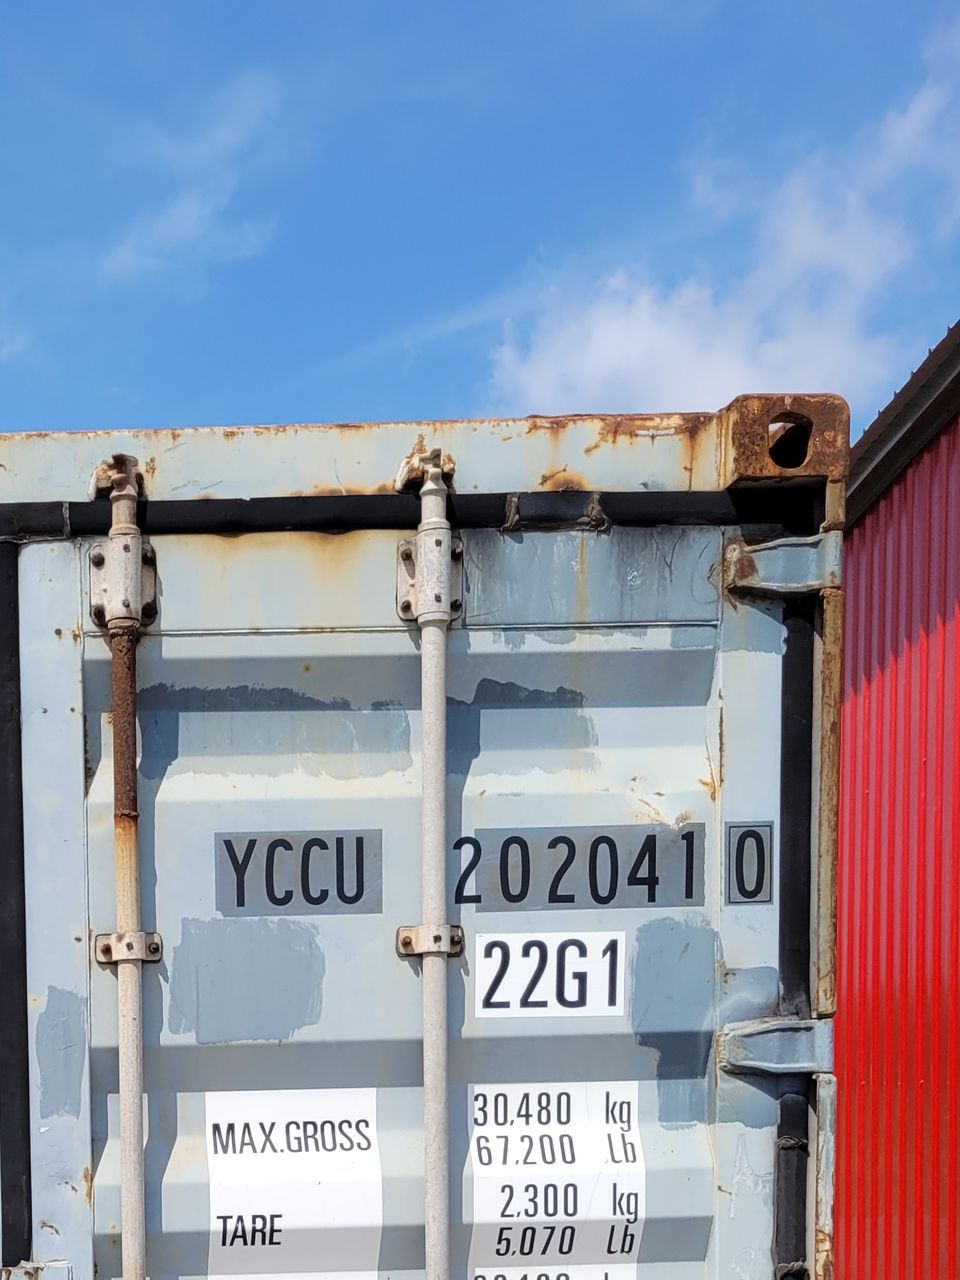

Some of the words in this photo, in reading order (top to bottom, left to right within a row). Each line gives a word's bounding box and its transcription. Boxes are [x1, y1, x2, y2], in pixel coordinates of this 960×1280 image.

[223, 836, 366, 908] YCCU
[452, 830, 697, 905] 202041
[736, 829, 767, 899] 0
[481, 938, 621, 1009] 22G1
[605, 1090, 631, 1132] kg
[211, 1119, 372, 1155] MAX.GROSS
[607, 1133, 637, 1164] Lb
[500, 1183, 578, 1219] 2,300
[612, 1182, 639, 1223] kg
[217, 1214, 283, 1247] TARE
[495, 1225, 575, 1256] 5,070
[606, 1224, 635, 1255] Lb
